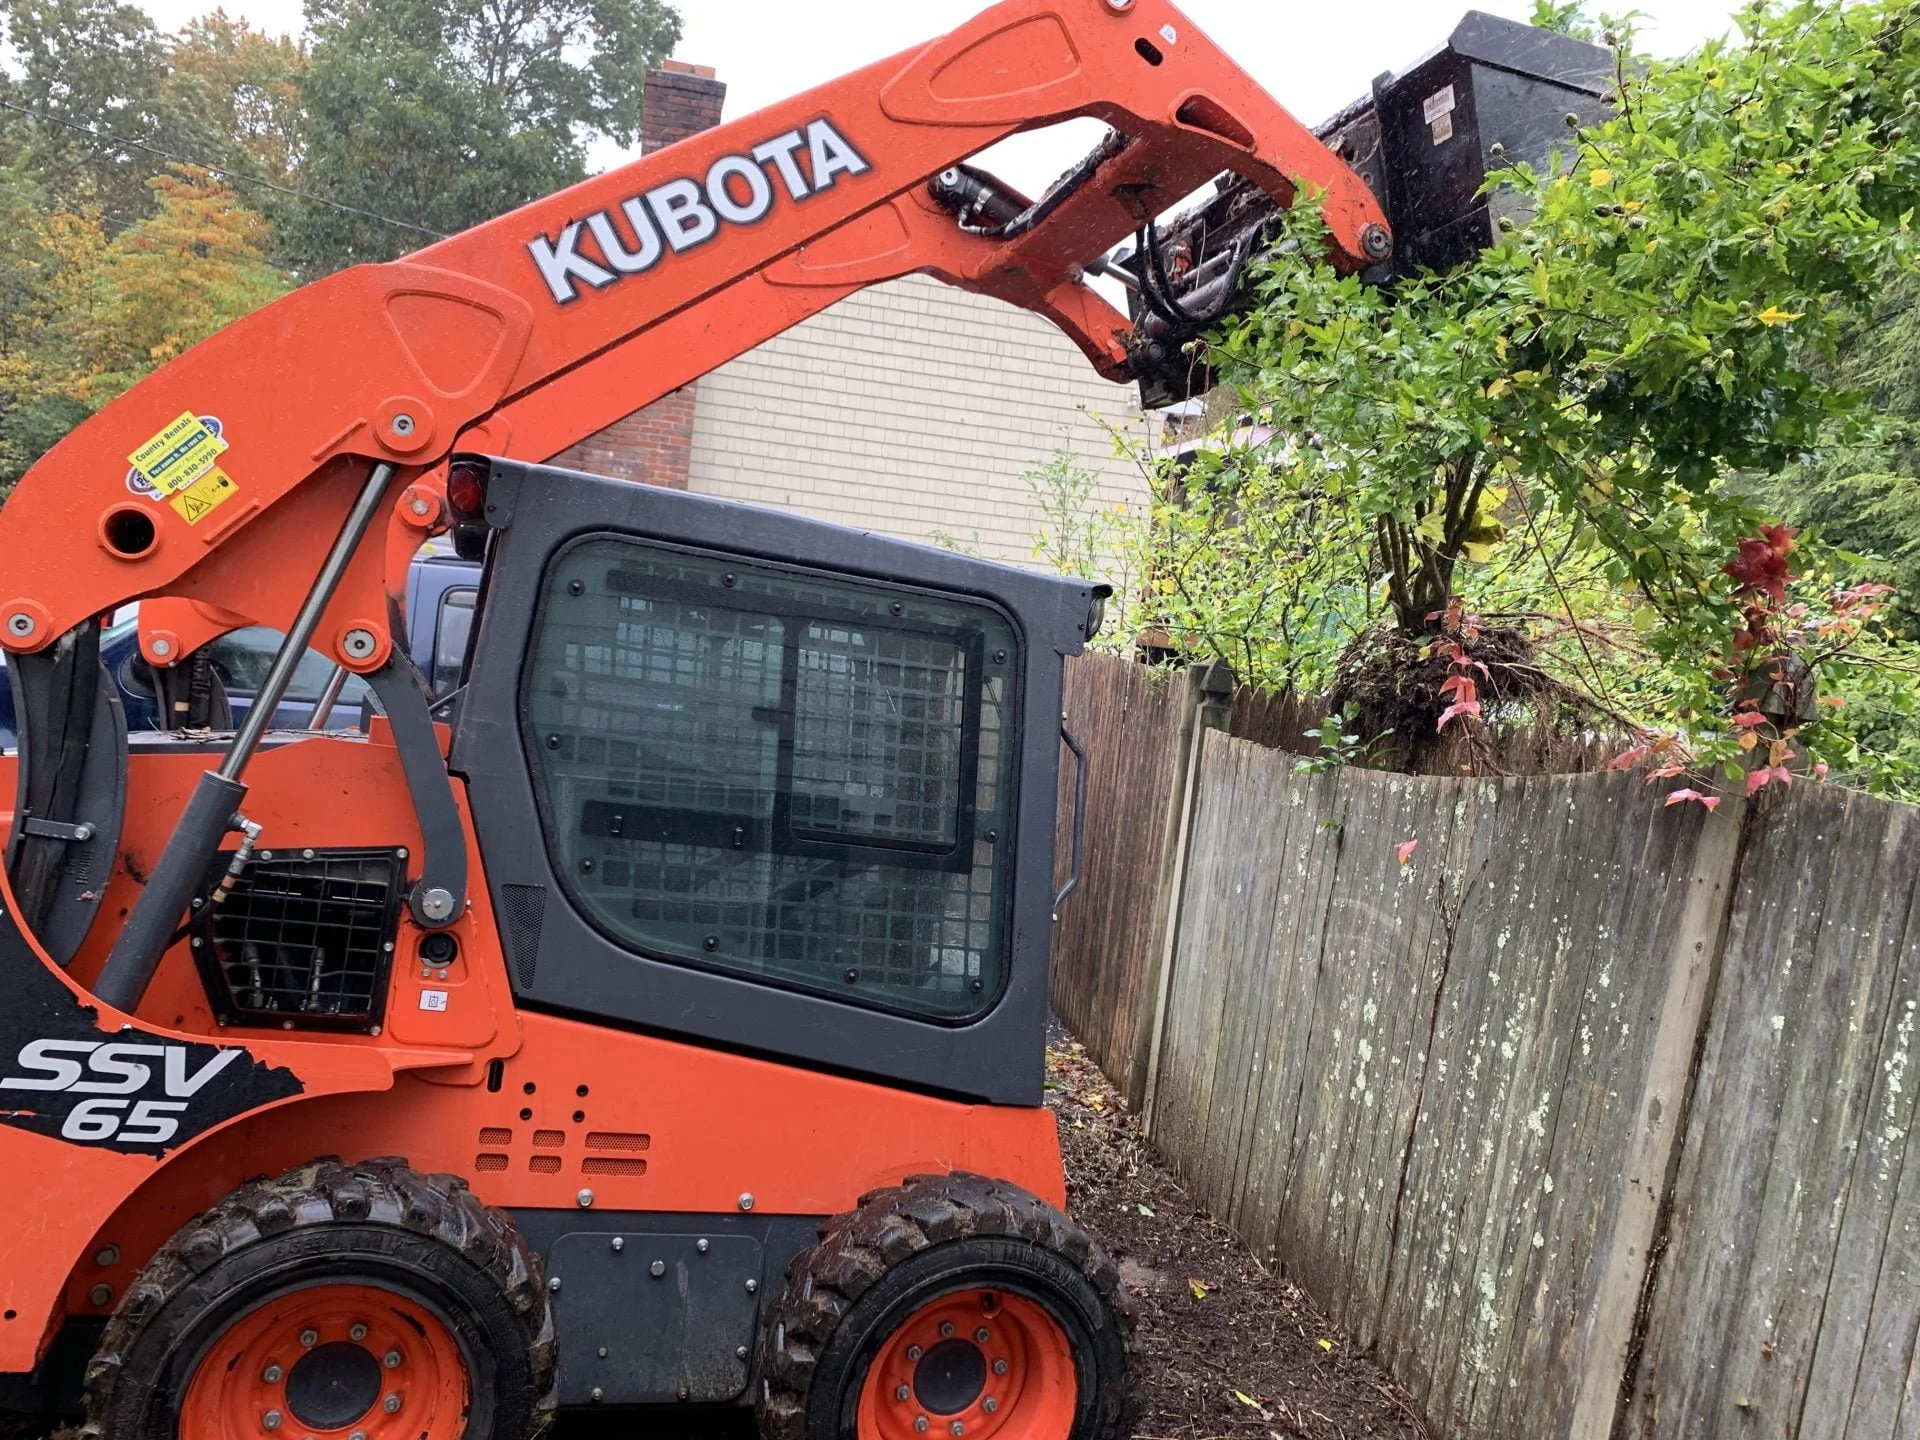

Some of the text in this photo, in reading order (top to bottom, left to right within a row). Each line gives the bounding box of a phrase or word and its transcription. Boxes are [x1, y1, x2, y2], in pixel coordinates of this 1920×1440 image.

[529, 118, 869, 303] KUBOTA
[135, 438, 165, 462] Country
[163, 417, 191, 440] Rentals
[150, 465, 162, 475] You
[186, 436, 199, 448] rent
[167, 448, 217, 489] 800-830-5990
[0, 1039, 243, 1098] SSV
[61, 1098, 189, 1144] 65
